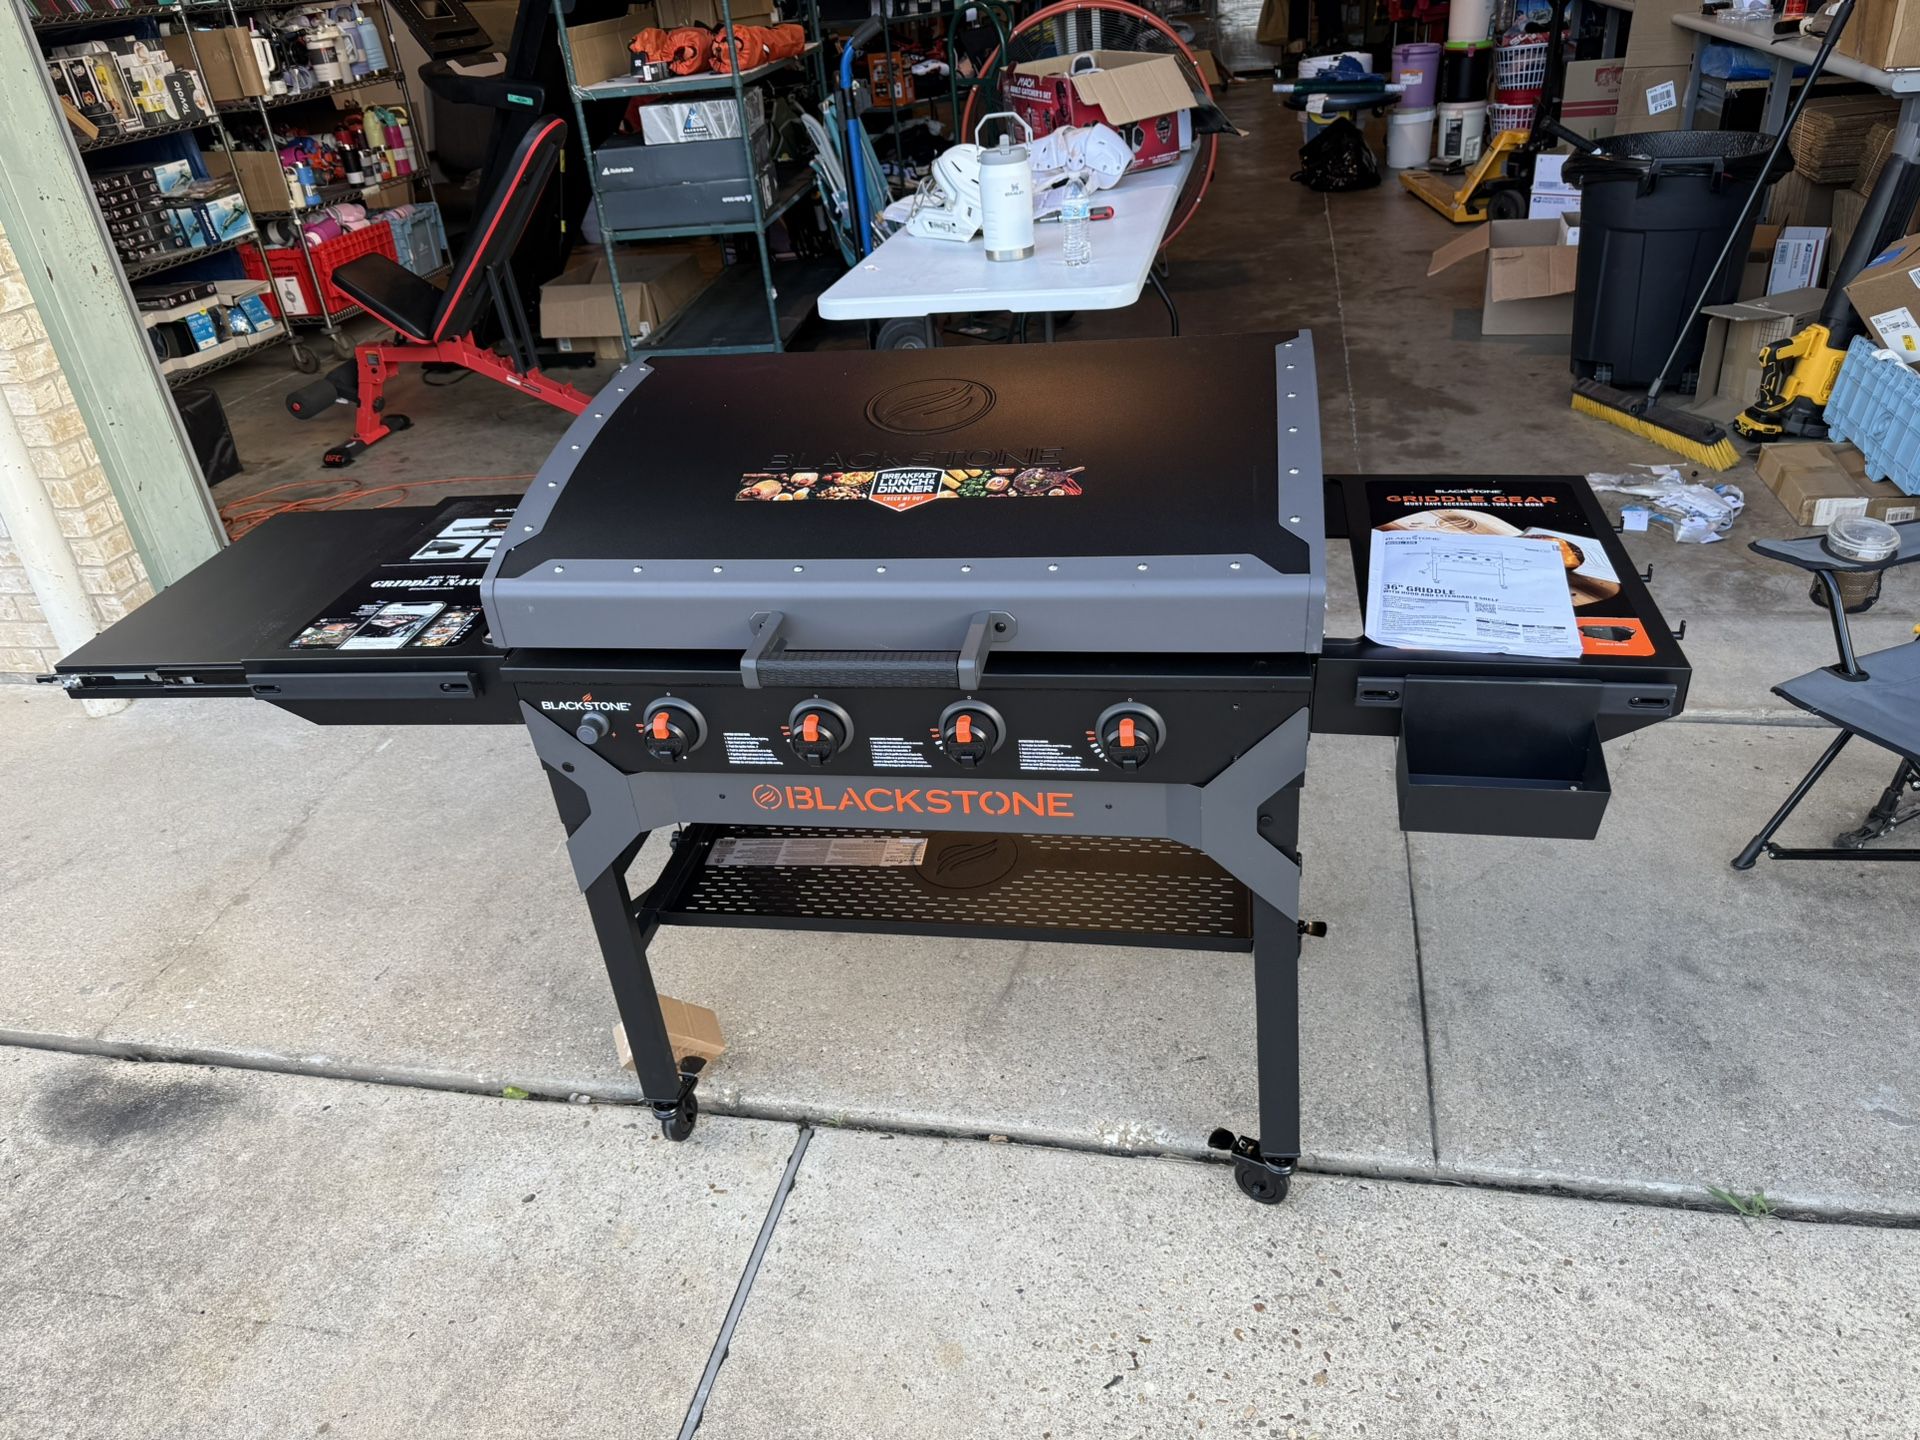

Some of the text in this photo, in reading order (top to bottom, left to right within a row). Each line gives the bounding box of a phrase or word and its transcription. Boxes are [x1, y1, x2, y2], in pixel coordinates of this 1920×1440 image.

[173, 81, 191, 115] Tovolo
[325, 454, 344, 462] UFC
[762, 447, 1066, 471] BLACKSTONE
[881, 472, 938, 480] BREAKFAST
[1386, 495, 1558, 504] GRIDDLE GEAR
[370, 579, 443, 588] GRIDDLE
[1406, 585, 1456, 595] GRIDDLE
[541, 701, 630, 711] BLACKSTONE
[784, 786, 1075, 817] BLACKSTONE
